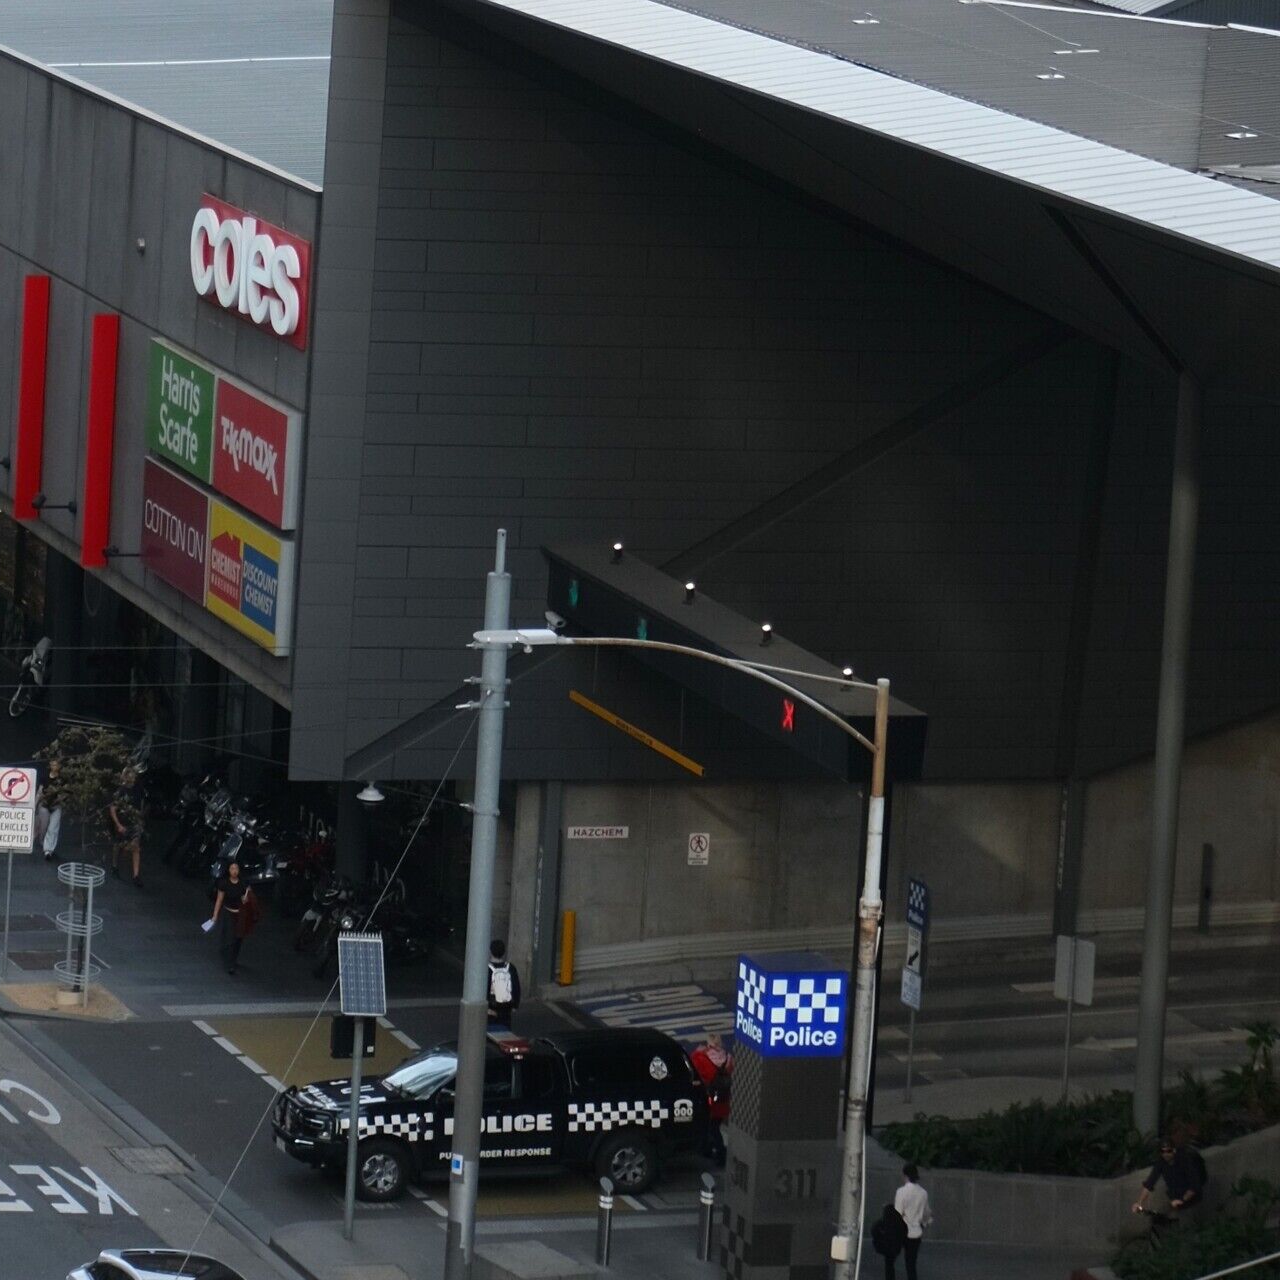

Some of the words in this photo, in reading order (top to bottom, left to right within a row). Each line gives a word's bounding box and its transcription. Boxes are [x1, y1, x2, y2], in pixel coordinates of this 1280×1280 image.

[190, 208, 301, 336] coles
[161, 355, 200, 417] Harris
[158, 402, 199, 465] Scarfe
[144, 498, 186, 552] COTTON
[187, 527, 204, 564] ON
[211, 547, 241, 584] CHEMIST
[243, 560, 277, 598] DISCOUNT
[244, 584, 274, 617] CHEMIST
[0, 811, 26, 820] POLICE
[573, 828, 624, 837] HAZCHEM
[736, 1010, 763, 1044] Police
[770, 1026, 837, 1047] Police
[504, 1147, 552, 1157] RESPONSE
